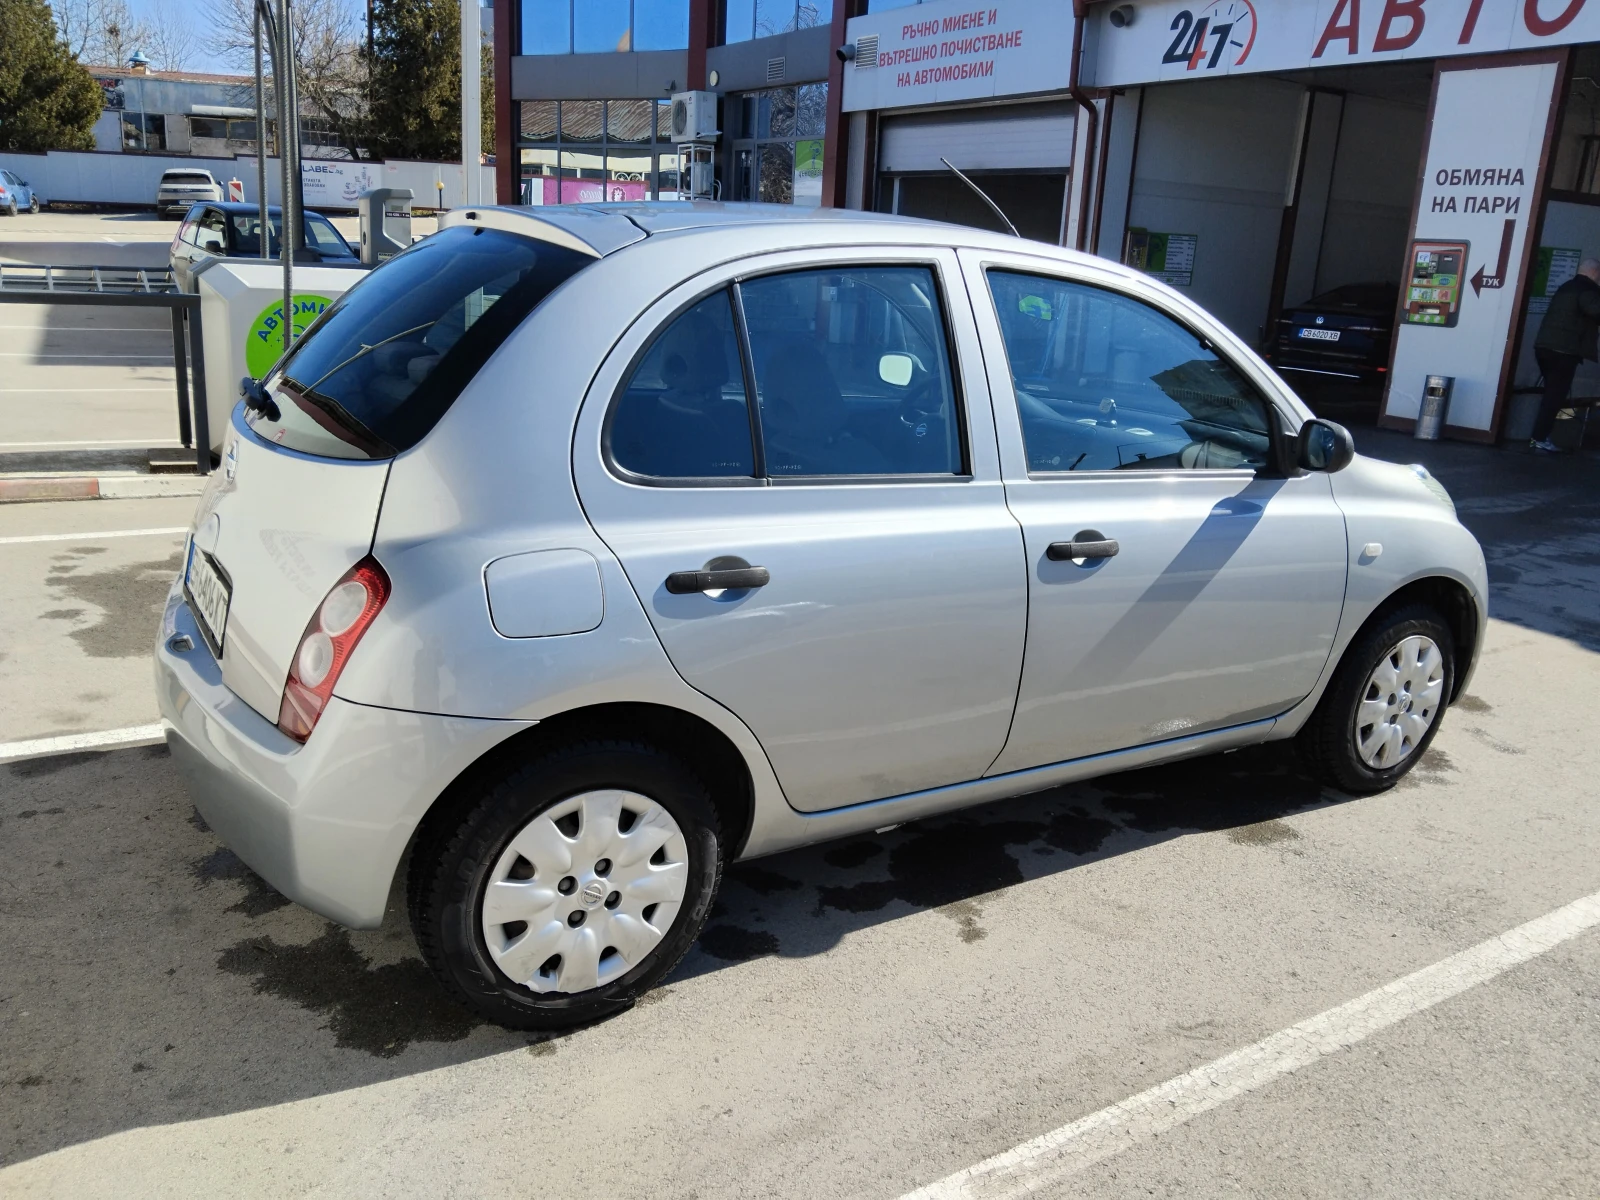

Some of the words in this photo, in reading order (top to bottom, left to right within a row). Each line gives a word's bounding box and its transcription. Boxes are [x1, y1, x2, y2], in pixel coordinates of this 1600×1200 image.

[902, 19, 939, 40] РЪЧНО
[942, 10, 985, 33] МИЕНЕ
[988, 8, 997, 25] И
[879, 44, 937, 67] ВЪТРЕШНО
[940, 30, 1023, 57] ПОЧИСТВАНЕ
[897, 72, 911, 87] НА
[913, 60, 994, 85] АВТОМОБИЛИ
[1435, 168, 1525, 186] ОБМЯНА
[1431, 196, 1457, 213] НА
[1463, 196, 1521, 214] ПАРИ
[1482, 277, 1500, 287] ТУК
[1312, 330, 1329, 339] 6020
